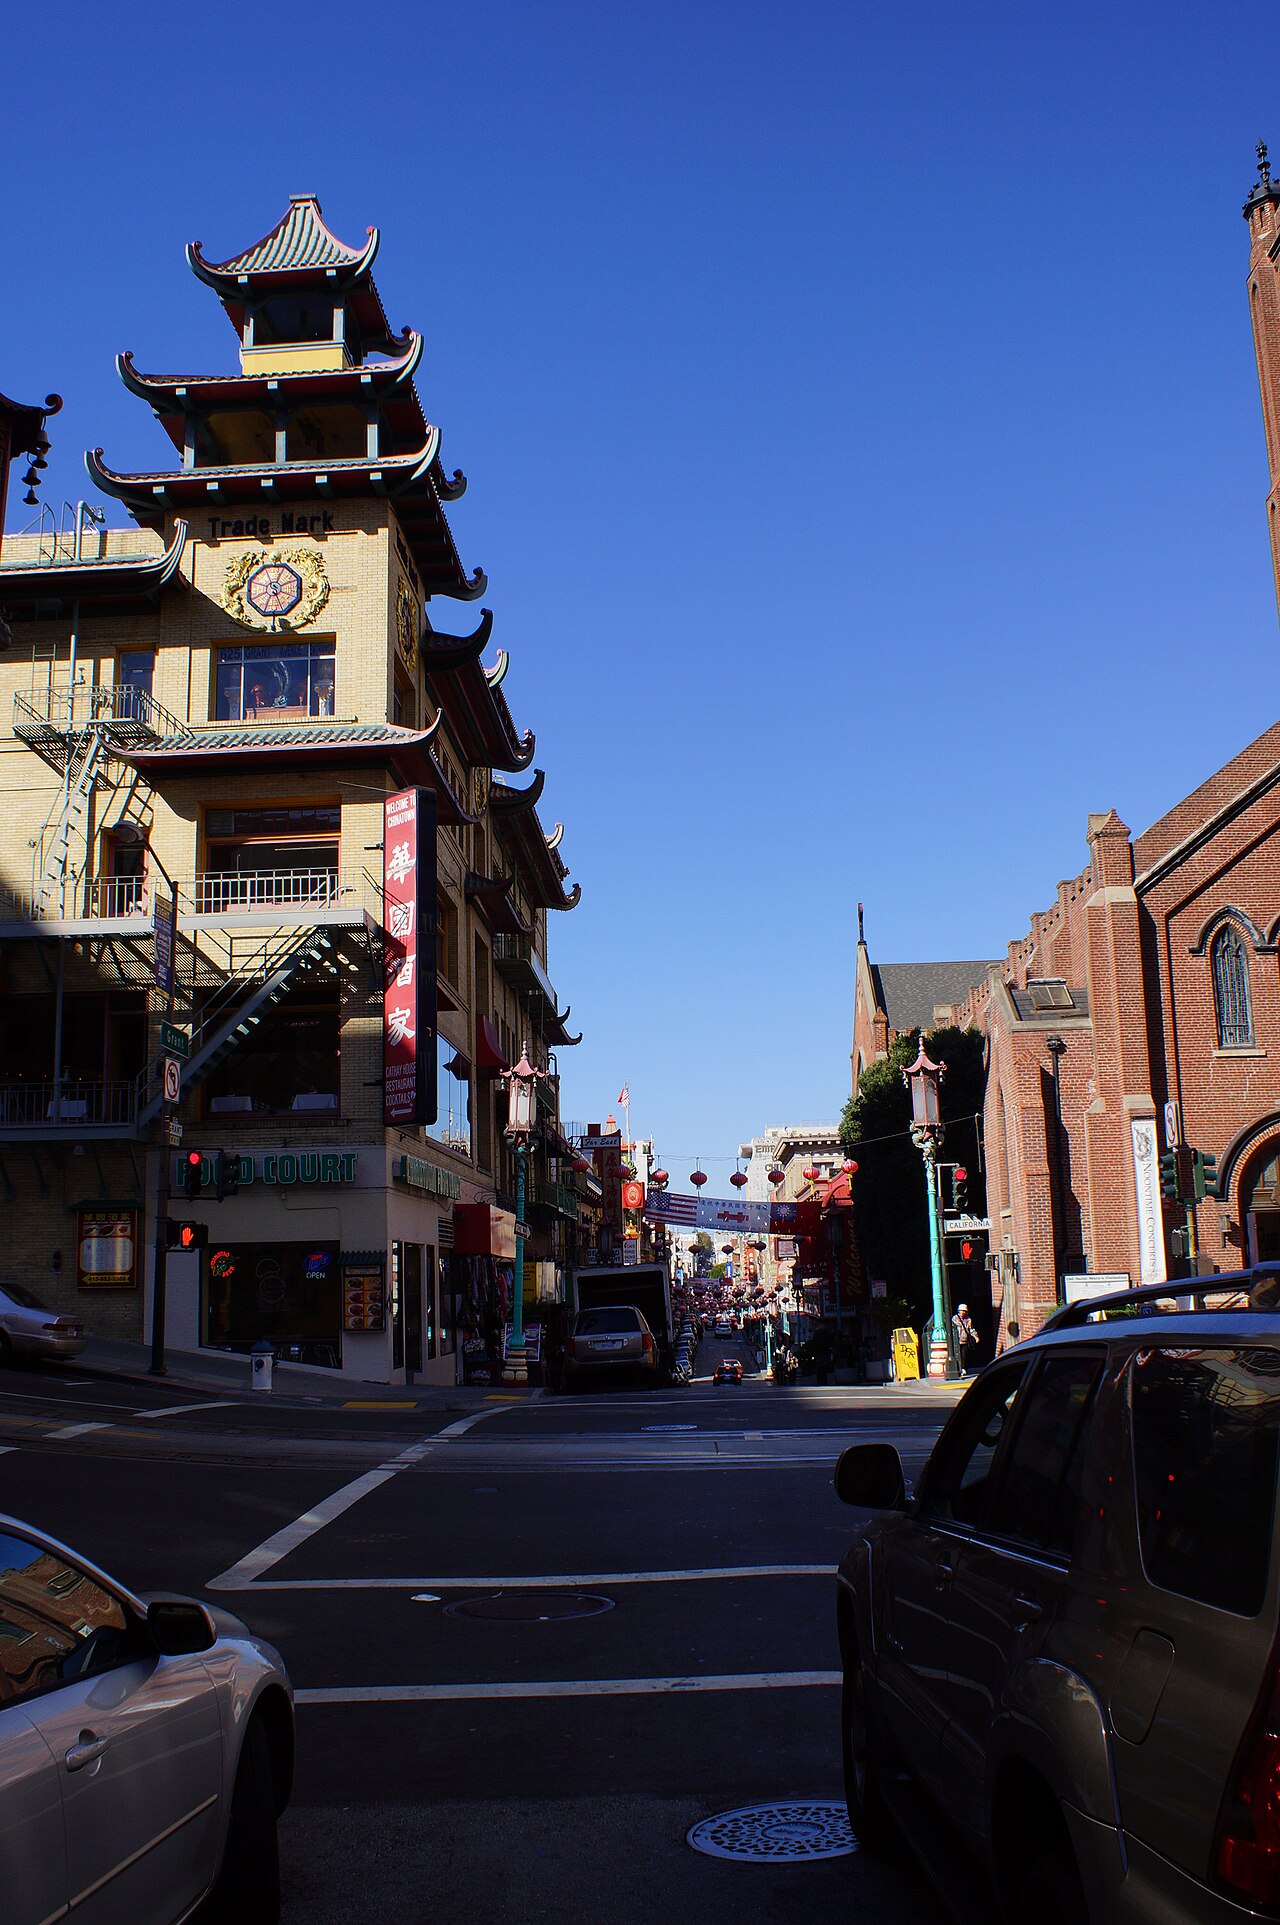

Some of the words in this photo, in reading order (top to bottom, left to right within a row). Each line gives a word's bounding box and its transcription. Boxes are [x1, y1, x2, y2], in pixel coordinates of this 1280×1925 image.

[208, 515, 270, 538] Trade
[282, 510, 335, 533] Mark
[386, 796, 409, 815] WELCOME
[387, 809, 415, 829] CHINATOWN
[167, 1028, 184, 1050] Grant
[385, 1064, 402, 1078] CATHAY
[402, 1061, 416, 1074] HOUSE
[385, 1076, 416, 1092] RESTAURANT
[385, 1093, 411, 1107] COCKTAILS
[584, 1138, 598, 1147] Far
[600, 1137, 617, 1146] East
[263, 1152, 357, 1185] COURT
[1143, 1163, 1153, 1214] NOONTIME
[949, 1220, 991, 1229] CALIFORNIA
[1147, 1217, 1157, 1267] CONCERTS
[845, 1218, 862, 1297] Welcome
[305, 1271, 326, 1280] OPEN
